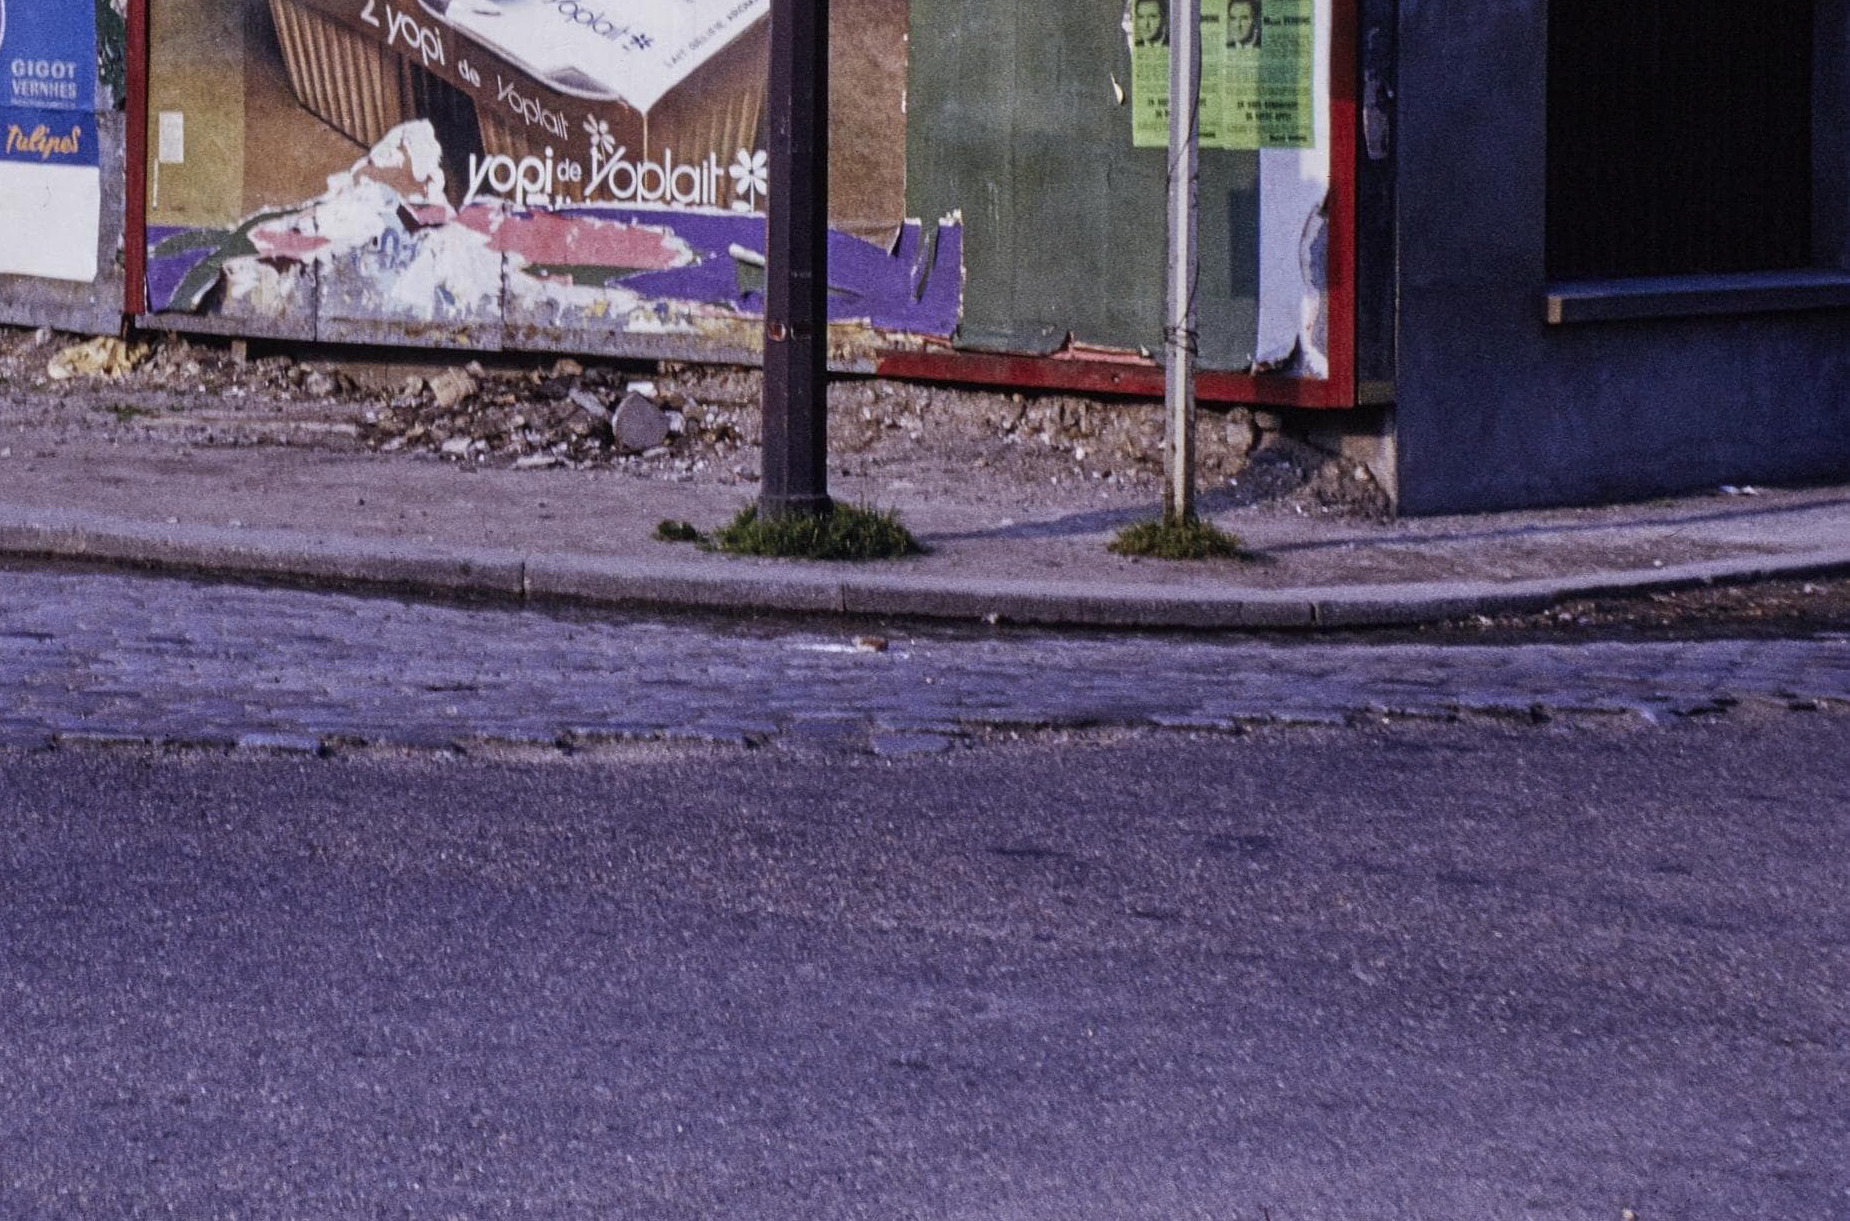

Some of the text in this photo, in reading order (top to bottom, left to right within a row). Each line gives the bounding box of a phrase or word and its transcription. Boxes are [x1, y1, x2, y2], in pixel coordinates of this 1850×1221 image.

[11, 59, 77, 79] GIGOT
[385, 4, 445, 66] yopi
[458, 59, 481, 88] de
[497, 75, 568, 141] Yoplait
[462, 146, 724, 211] yopi de Yoplait
